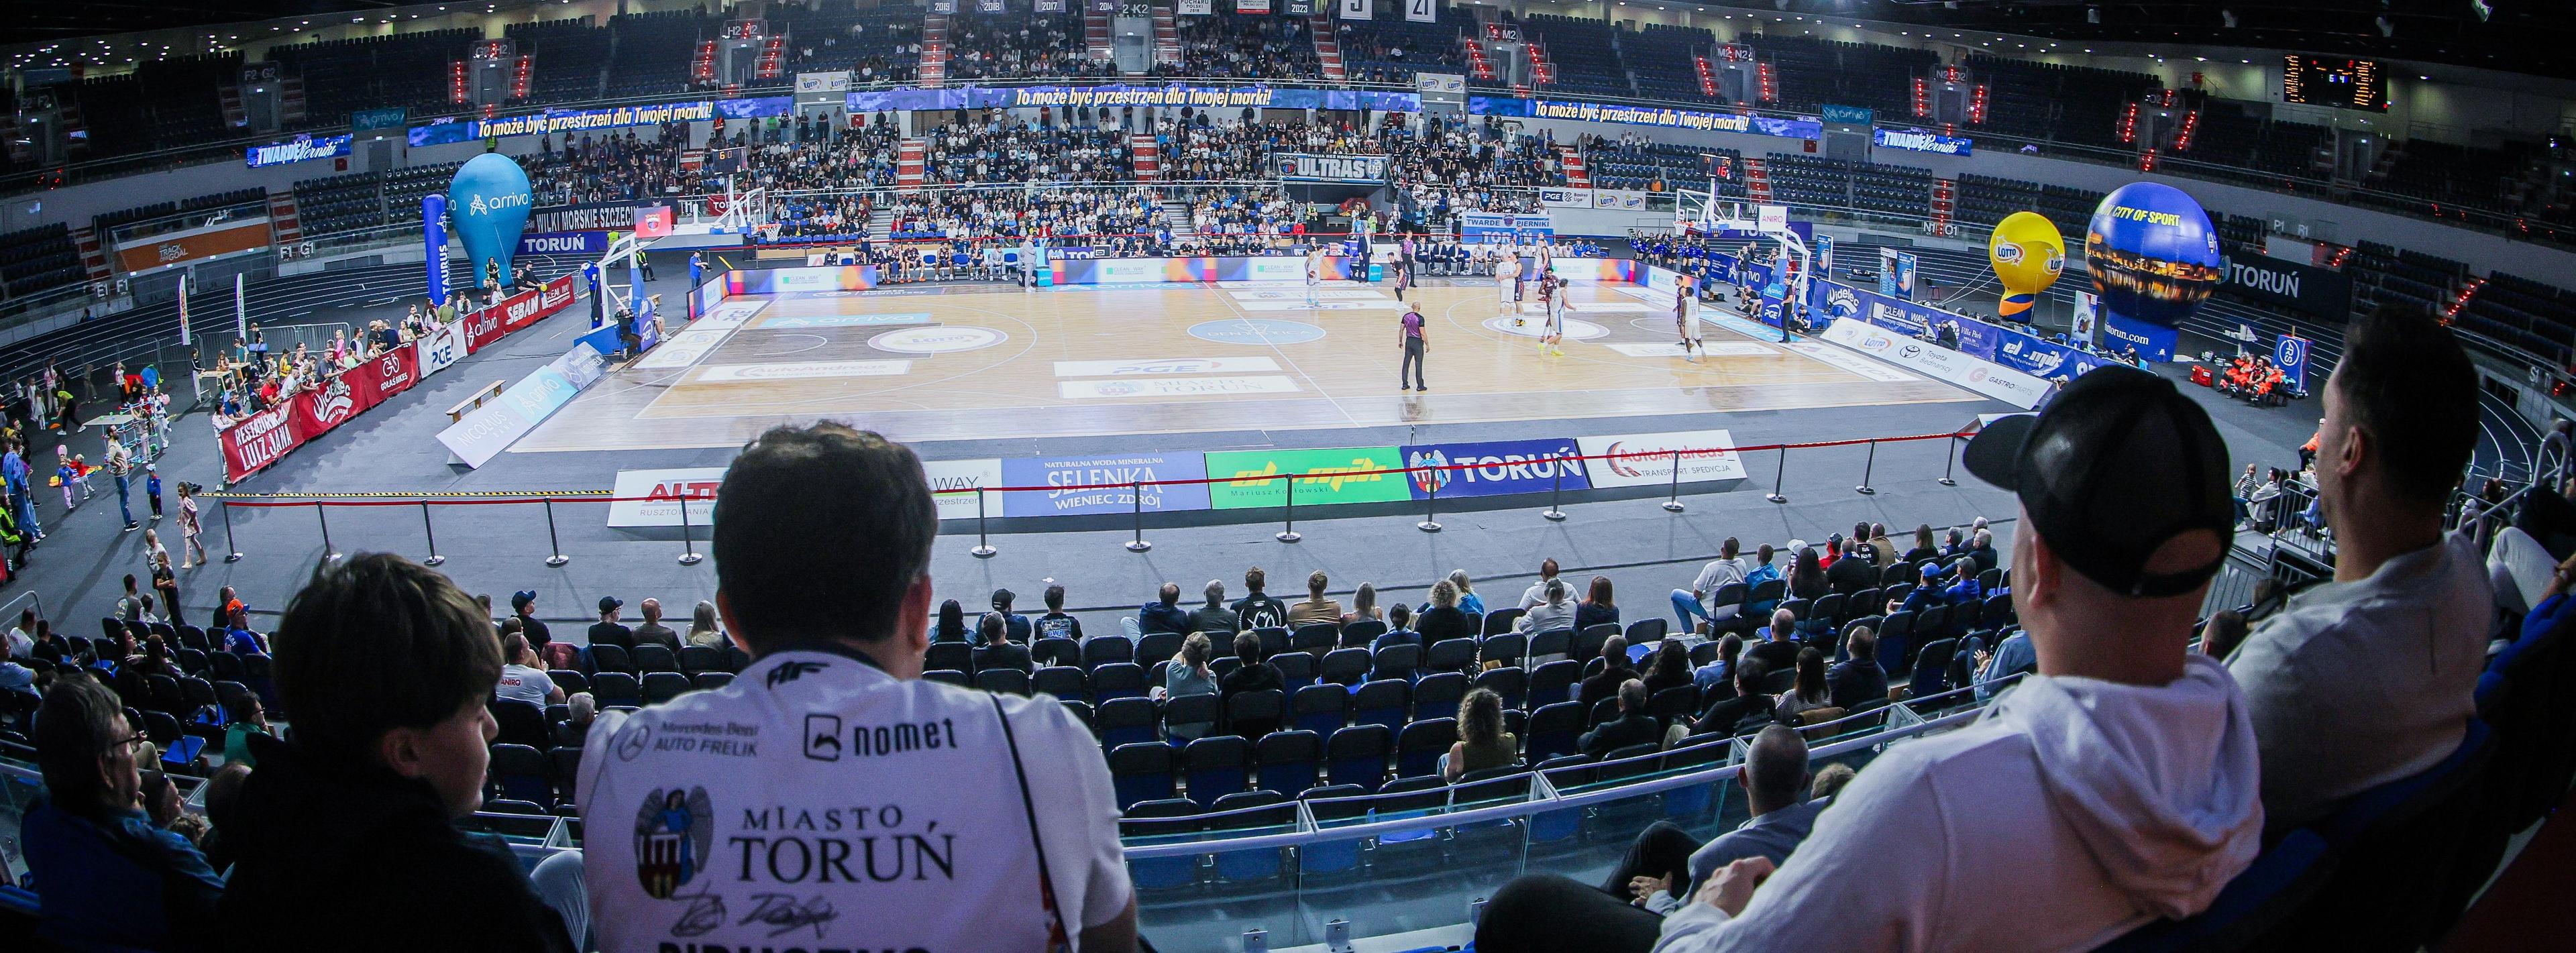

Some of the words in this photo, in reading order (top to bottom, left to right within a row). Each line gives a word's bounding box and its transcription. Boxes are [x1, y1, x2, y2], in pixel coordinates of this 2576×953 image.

[934, 3, 950, 11] 2019
[1042, 2, 1058, 11] 2017
[1099, 2, 1114, 11] 2014
[1132, 4, 1148, 14] K2
[1291, 4, 1308, 13] 2023
[1503, 30, 1516, 40] M2
[1735, 49, 1748, 59] N2
[244, 69, 257, 80] F2
[262, 68, 275, 78] G2
[803, 79, 818, 89] LOTTO
[831, 78, 845, 88] LOTTO
[1422, 80, 1436, 88] LOTTO
[1447, 82, 1461, 90] LOTTO
[1016, 89, 1029, 105] To
[1032, 89, 1067, 105] może
[1069, 89, 1093, 109] być
[1095, 89, 1163, 108] przestrzeń
[1165, 89, 1185, 104] dla
[1189, 89, 1228, 108] Twojej
[1230, 89, 1272, 105] marki!
[479, 121, 491, 138] To
[492, 117, 524, 136] może
[525, 113, 547, 134] być
[548, 109, 611, 133] przestrzeń
[614, 107, 631, 125] dla
[635, 104, 672, 124] Twojej
[674, 101, 713, 121] marki!
[1535, 101, 1548, 115] To
[1549, 103, 1576, 119] może
[1579, 105, 1600, 122] być
[1601, 107, 1658, 125] przestrzeń
[1660, 109, 1677, 125] dla
[1679, 111, 1713, 130] Twojej
[1715, 115, 1750, 132] marki!
[1884, 131, 1925, 150] TWARDE
[258, 142, 301, 165] TWARDE
[1297, 158, 1365, 178] ULTRAS
[490, 192, 529, 209] arriva
[536, 211, 559, 233] WILKI
[562, 208, 598, 231] MORSKIE
[2114, 206, 2135, 219] CITY
[2133, 209, 2148, 222] OF
[2148, 211, 2181, 226] SPORT
[525, 234, 585, 253] TORUŃ
[1482, 230, 1534, 243] TORŃ
[159, 243, 180, 257] TRACK
[168, 248, 189, 261] GOAL
[280, 245, 292, 260] F1
[300, 240, 315, 257] G1
[1997, 245, 2017, 258] LOTTO
[441, 244, 451, 295] TAURUS
[117, 278, 128, 293] F1
[2233, 263, 2300, 298] TORUŃ
[1827, 287, 1859, 307] Widelec
[505, 292, 539, 325] SEBAN
[1764, 308, 1778, 320] PGE
[1884, 304, 1906, 319] CLEAN
[1911, 311, 1926, 323] WAY
[809, 314, 914, 324] arriva
[912, 335, 965, 343] LOTTO
[1961, 327, 1971, 336] Villa
[1972, 329, 1983, 339] Park
[1864, 337, 1886, 347] LOTTO
[432, 345, 451, 365] PGE
[1927, 350, 1948, 362] Toyota
[1112, 364, 1201, 374] PGE
[1919, 357, 1953, 373] Bednarscy
[380, 375, 396, 392] GOŁAŚ
[394, 372, 409, 385] BIKES
[1988, 376, 2035, 396] GASTROPARTS
[528, 378, 561, 404] arriva
[457, 410, 508, 447] NICOLAUS
[1620, 445, 1725, 463] AutoAndreas
[1044, 460, 1091, 469] NATURALNA
[1118, 457, 1164, 465] MINERALNA
[1454, 447, 1582, 483] TORUŃ
[1691, 465, 1731, 475] SPEDYCJA
[934, 476, 979, 490] WAY
[1046, 466, 1164, 500] SELENKA
[1275, 486, 1328, 495] Kołowski
[1055, 494, 1114, 511] WIENIEC
[1117, 492, 1161, 509] ZDRÓJ
[500, 678, 521, 686] ANIRO
[854, 717, 958, 756] nomet
[653, 737, 697, 752] AUTO
[700, 739, 758, 757] FRELIK
[742, 803, 904, 832] MIASTO
[729, 820, 959, 885] TORUŃ
